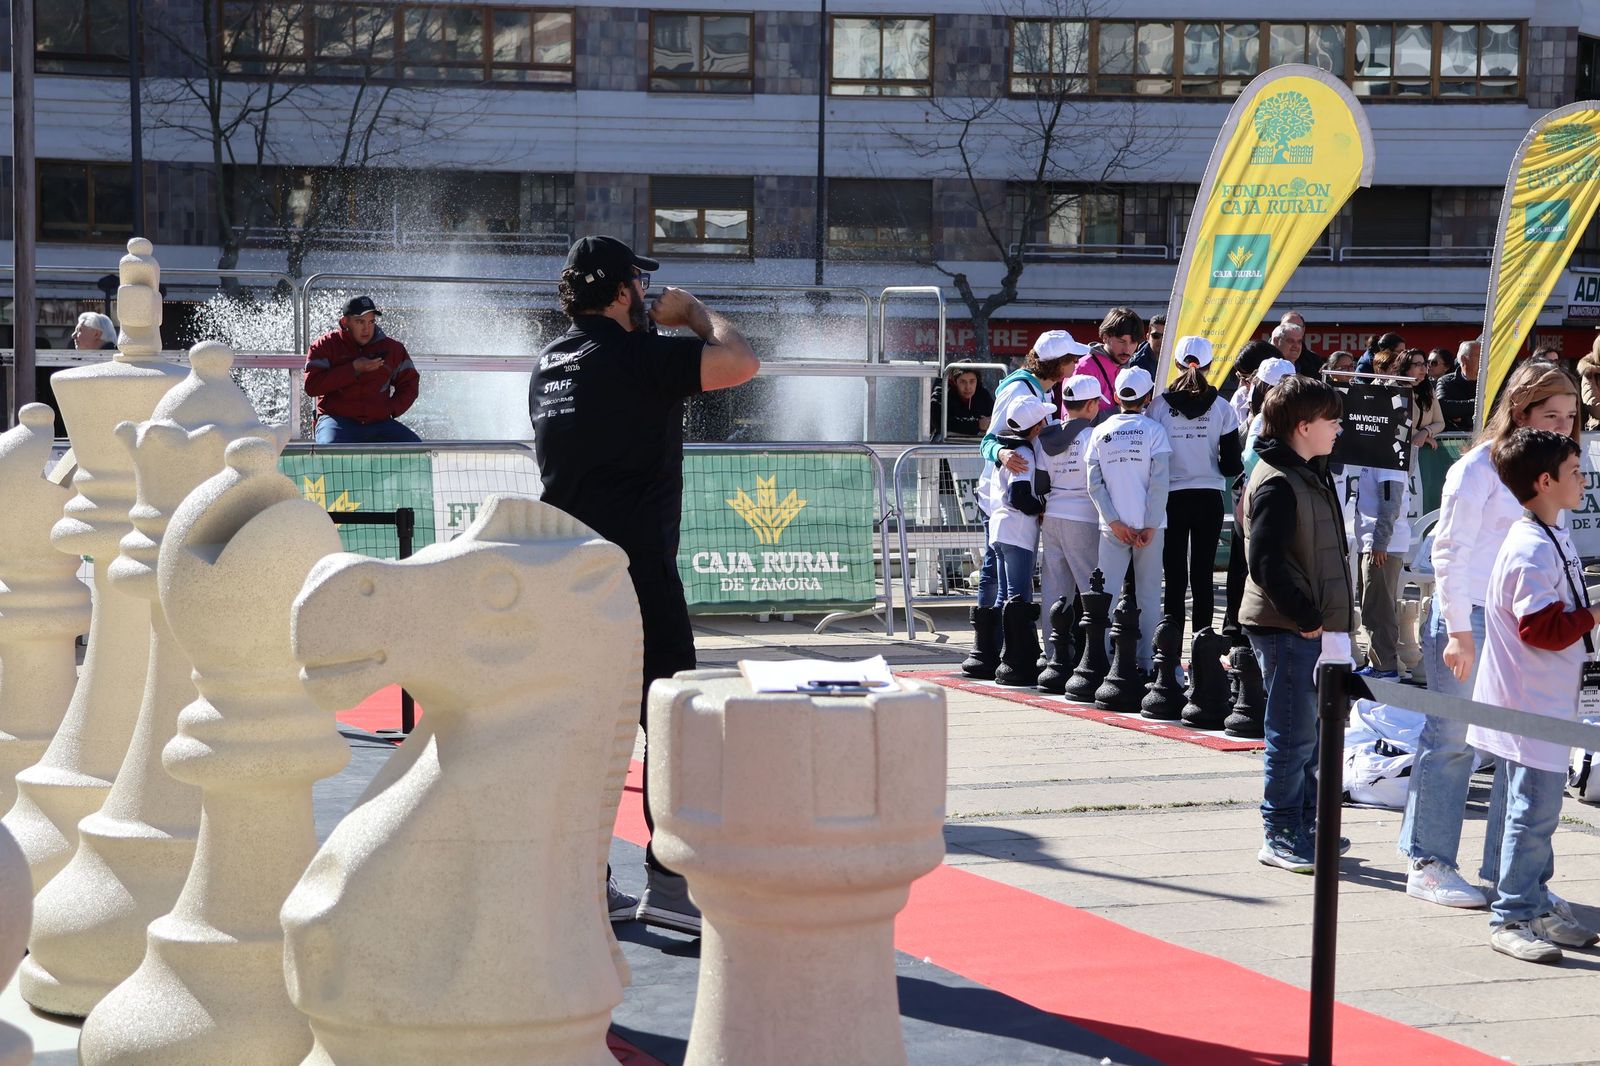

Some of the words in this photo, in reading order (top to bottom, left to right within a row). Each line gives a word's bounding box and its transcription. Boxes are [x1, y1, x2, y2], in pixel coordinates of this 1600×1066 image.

[1220, 199, 1261, 216] CAJA
[1265, 199, 1328, 214] RURAL
[1212, 270, 1233, 278] CAJA
[1235, 270, 1262, 278] RURAL
[563, 364, 581, 373] 2026
[543, 379, 573, 394] STAFF
[1349, 413, 1361, 421] SAN
[1362, 415, 1389, 424] VICENTE
[1355, 423, 1364, 431] DE
[1365, 424, 1381, 433] PAÚL
[692, 551, 757, 575] CAJA
[761, 551, 849, 574] RURAL
[720, 577, 745, 592] DE
[751, 577, 823, 592] ZAMORA
